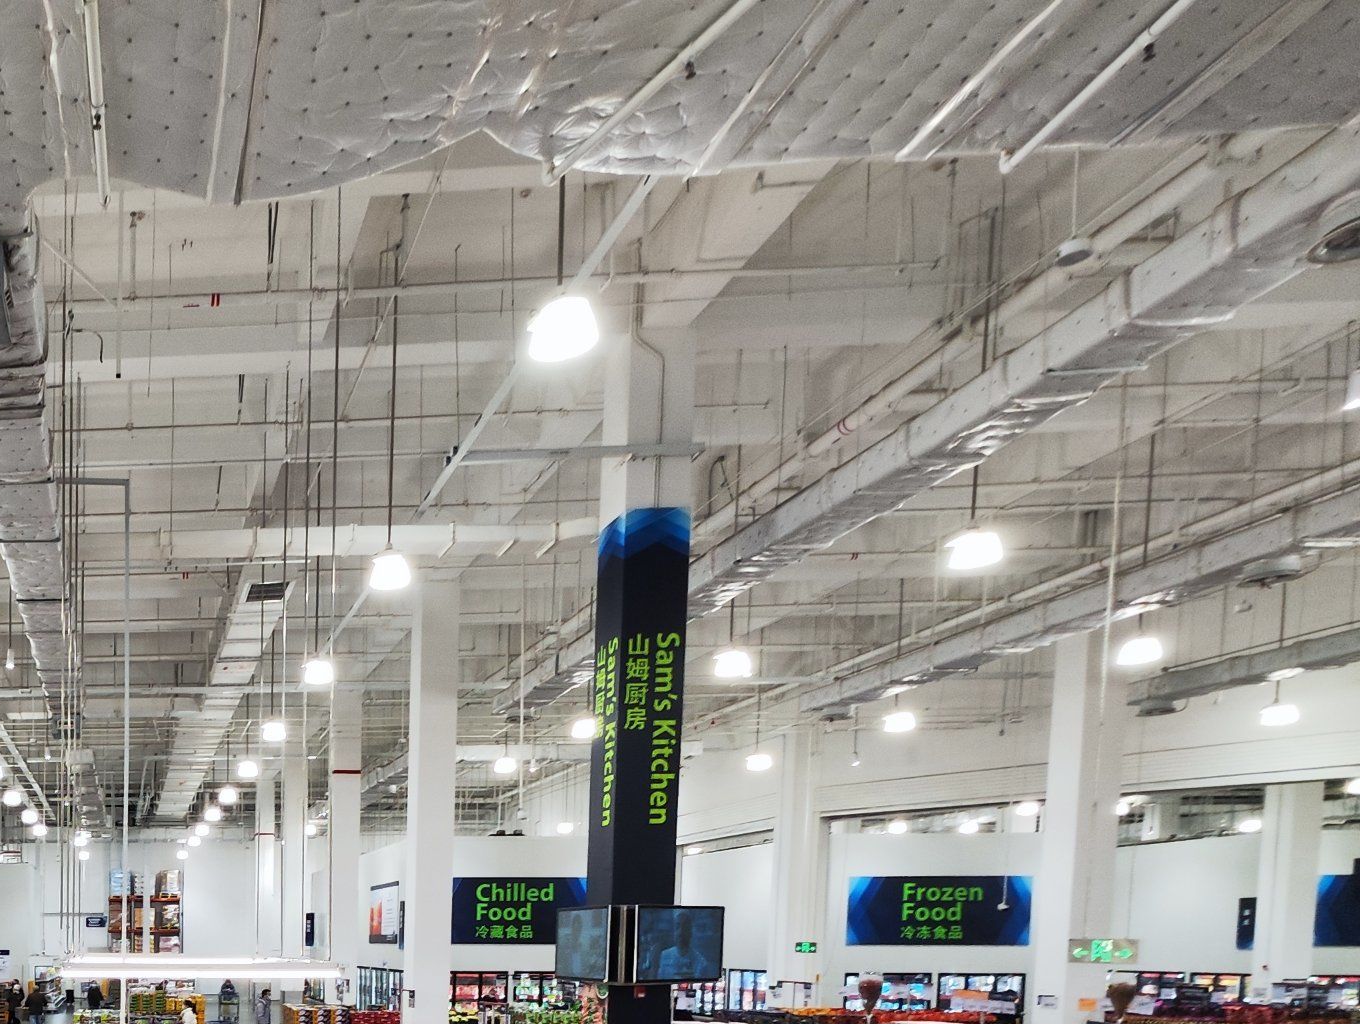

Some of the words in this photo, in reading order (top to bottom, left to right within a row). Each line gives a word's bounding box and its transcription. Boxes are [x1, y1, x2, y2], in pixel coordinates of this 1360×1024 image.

[623, 632, 650, 731] 山姆厨房
[652, 632, 681, 712] Sam's
[601, 720, 617, 827] Kitchen
[648, 719, 676, 826] Kitchen
[475, 882, 555, 902] Chilled
[902, 882, 984, 902] Frozen
[475, 902, 532, 921] Food
[901, 901, 963, 921] Food
[475, 924, 534, 939] 冷藏食品
[900, 925, 963, 939] 冷冻食品
